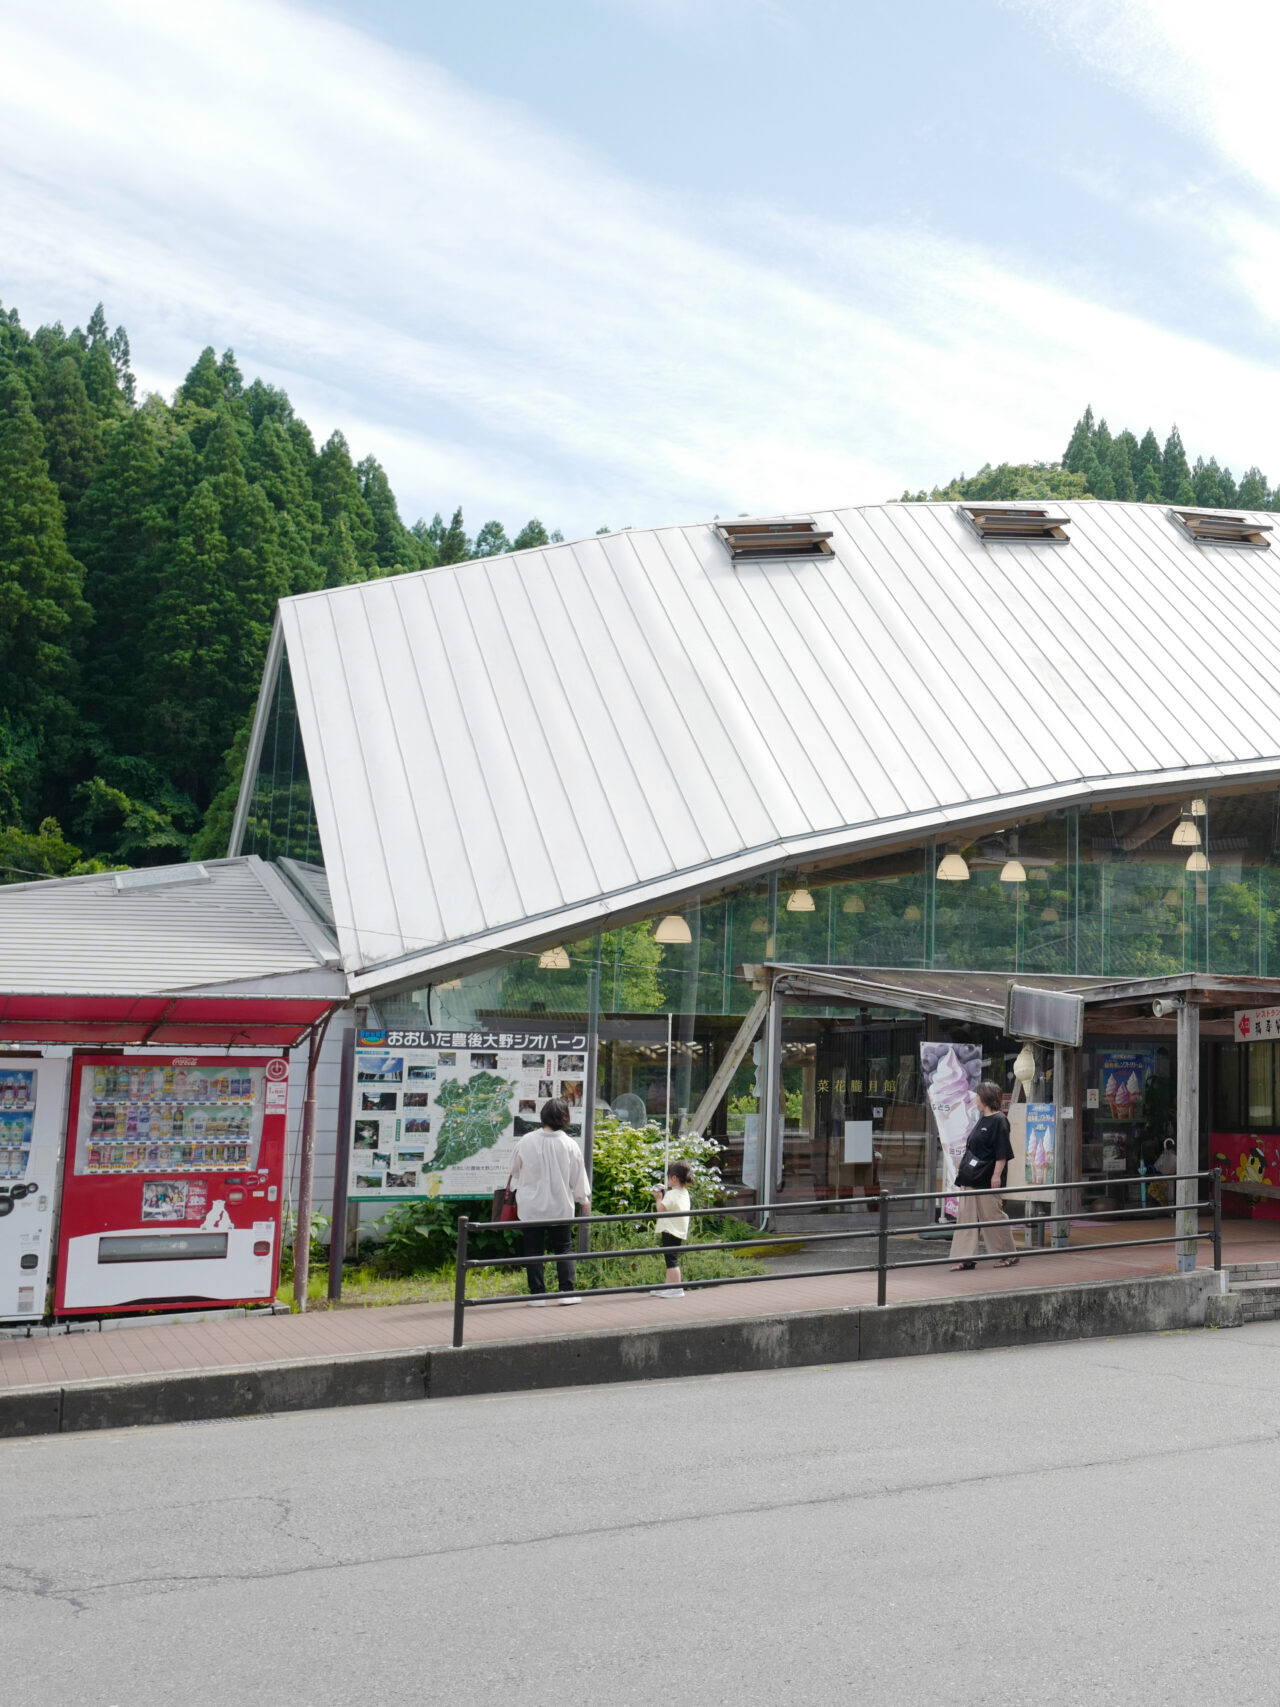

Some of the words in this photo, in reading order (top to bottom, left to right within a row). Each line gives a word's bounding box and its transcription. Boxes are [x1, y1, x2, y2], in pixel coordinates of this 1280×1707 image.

[1256, 1009, 1280, 1018] レストラン
